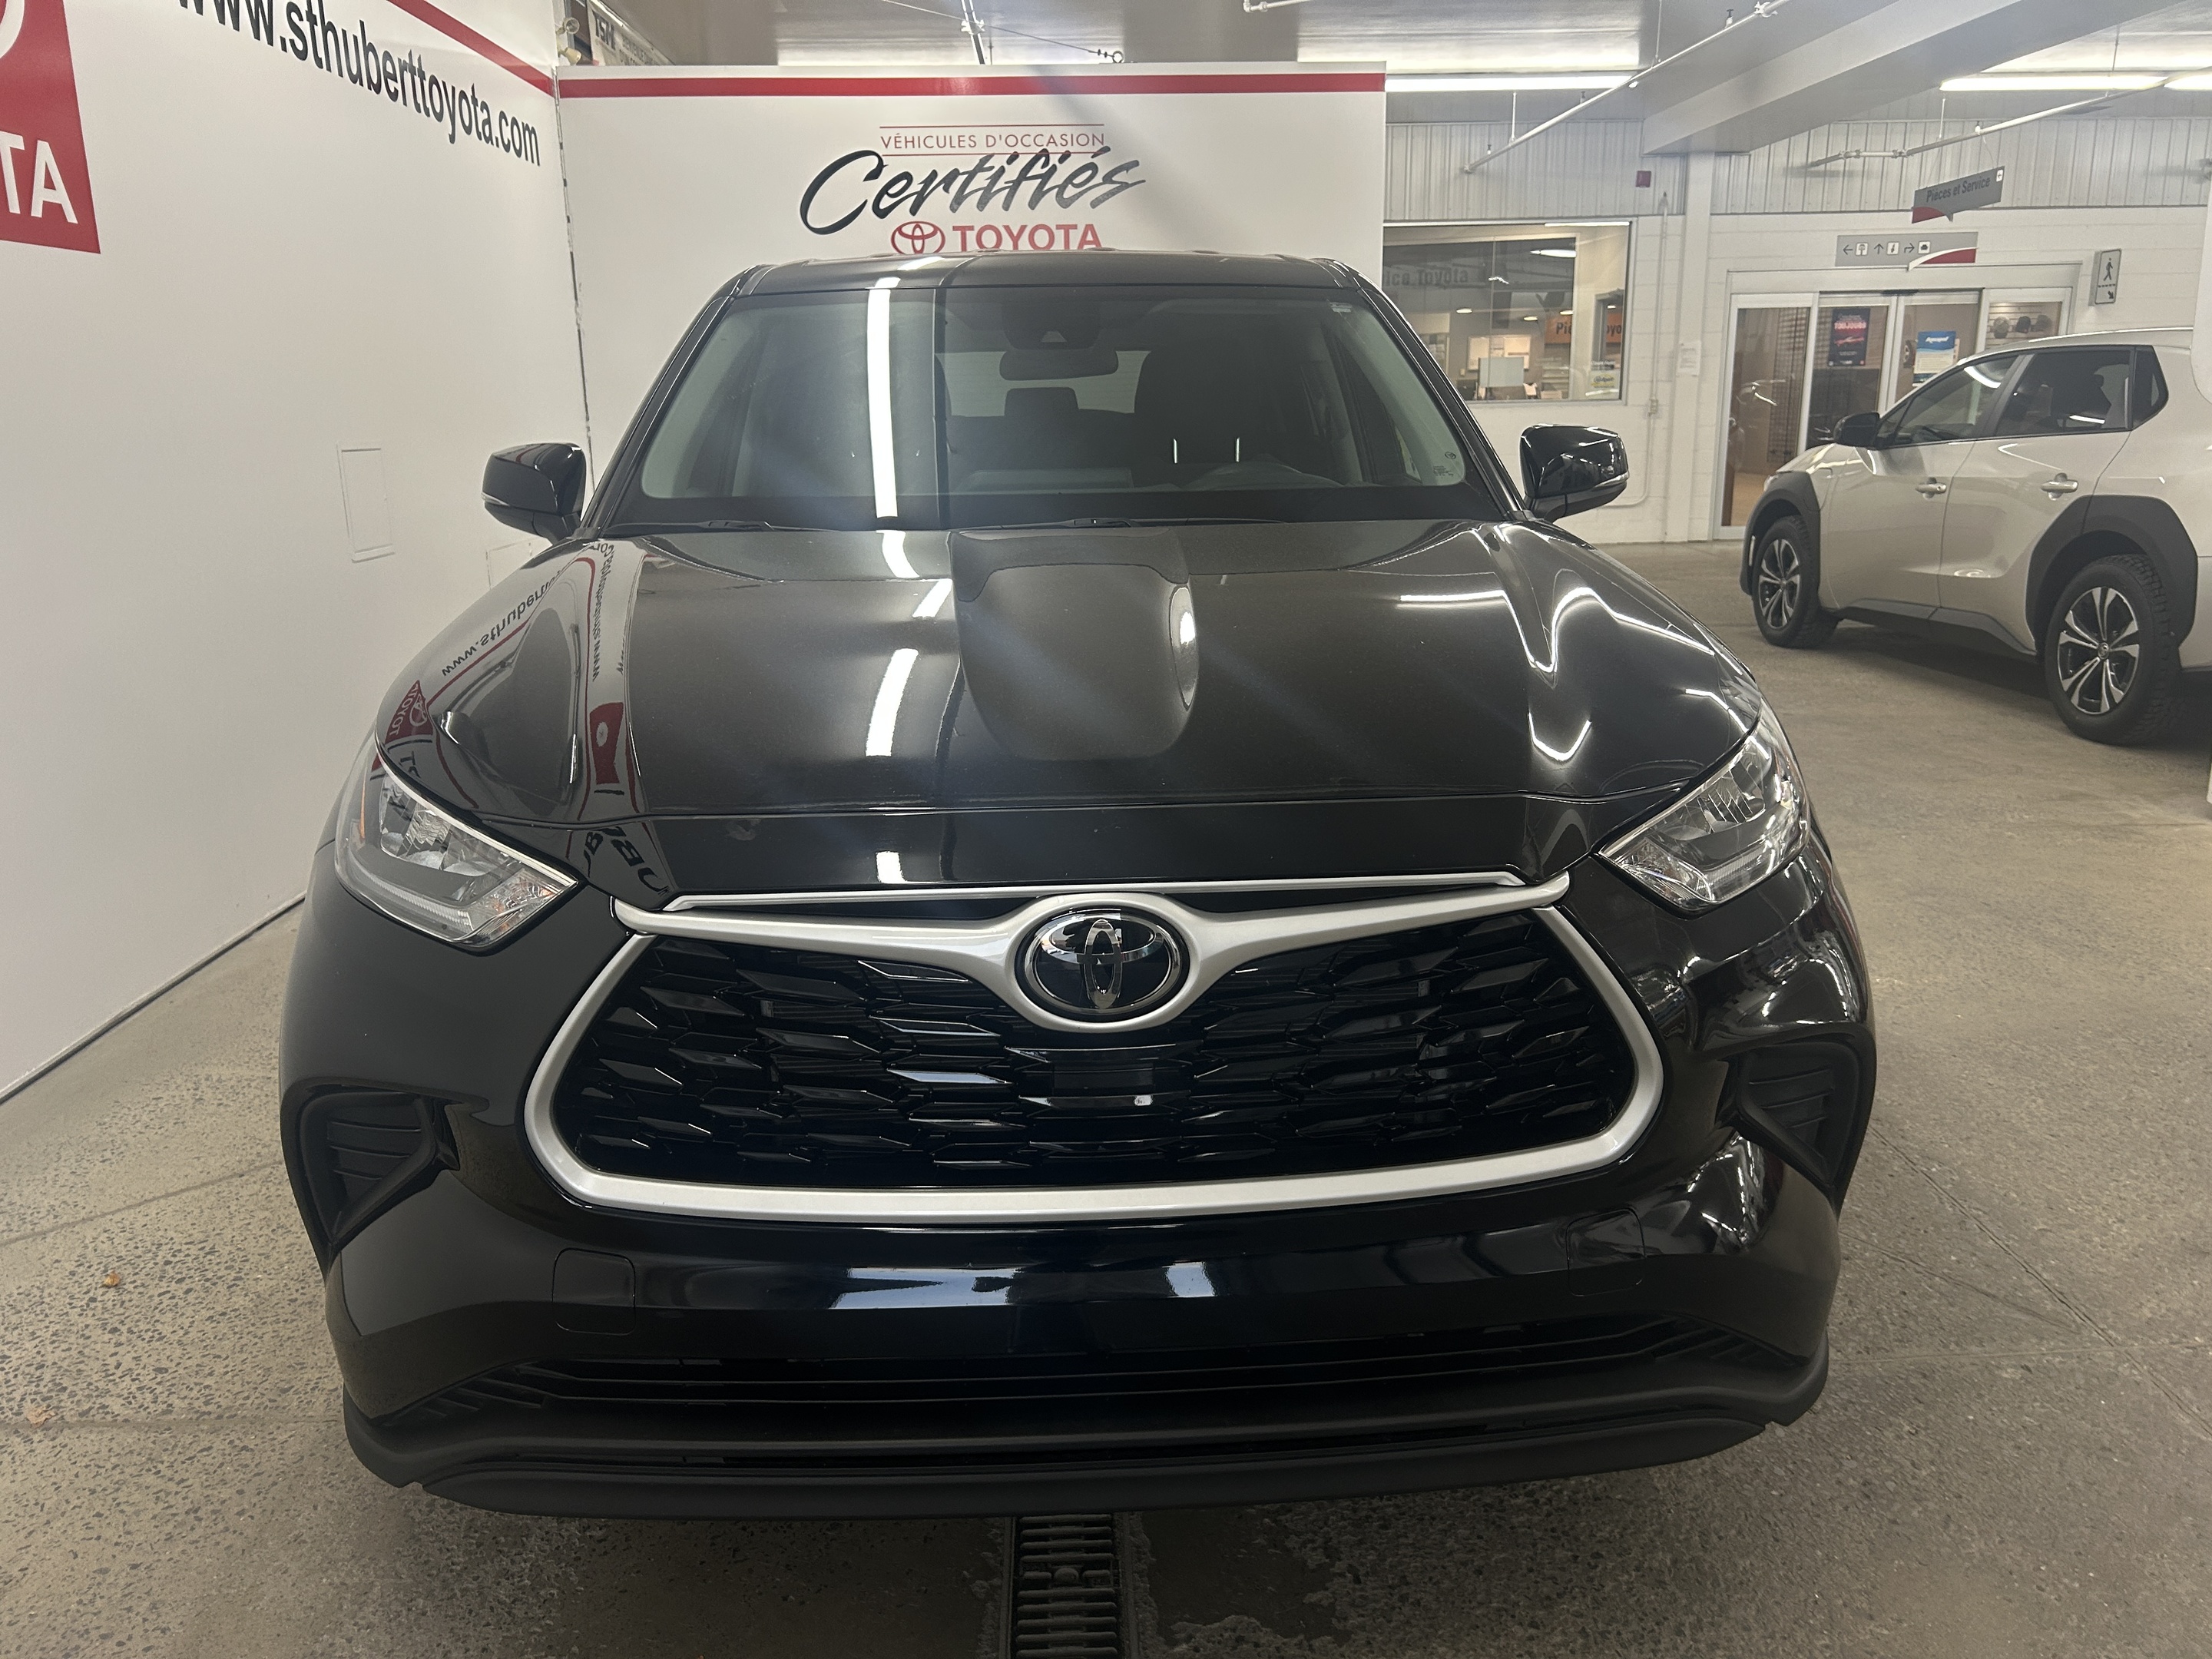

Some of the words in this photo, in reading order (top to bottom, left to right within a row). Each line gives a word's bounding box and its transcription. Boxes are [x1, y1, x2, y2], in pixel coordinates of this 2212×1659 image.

[179, 0, 540, 166] w.sthuberttoyota.com
[880, 134, 977, 150] VÉHICULES
[985, 132, 1105, 148] D'OCCASION
[800, 145, 1146, 235] Certifiés
[1962, 176, 1991, 194] Service
[952, 224, 1101, 250] TOYOTA
